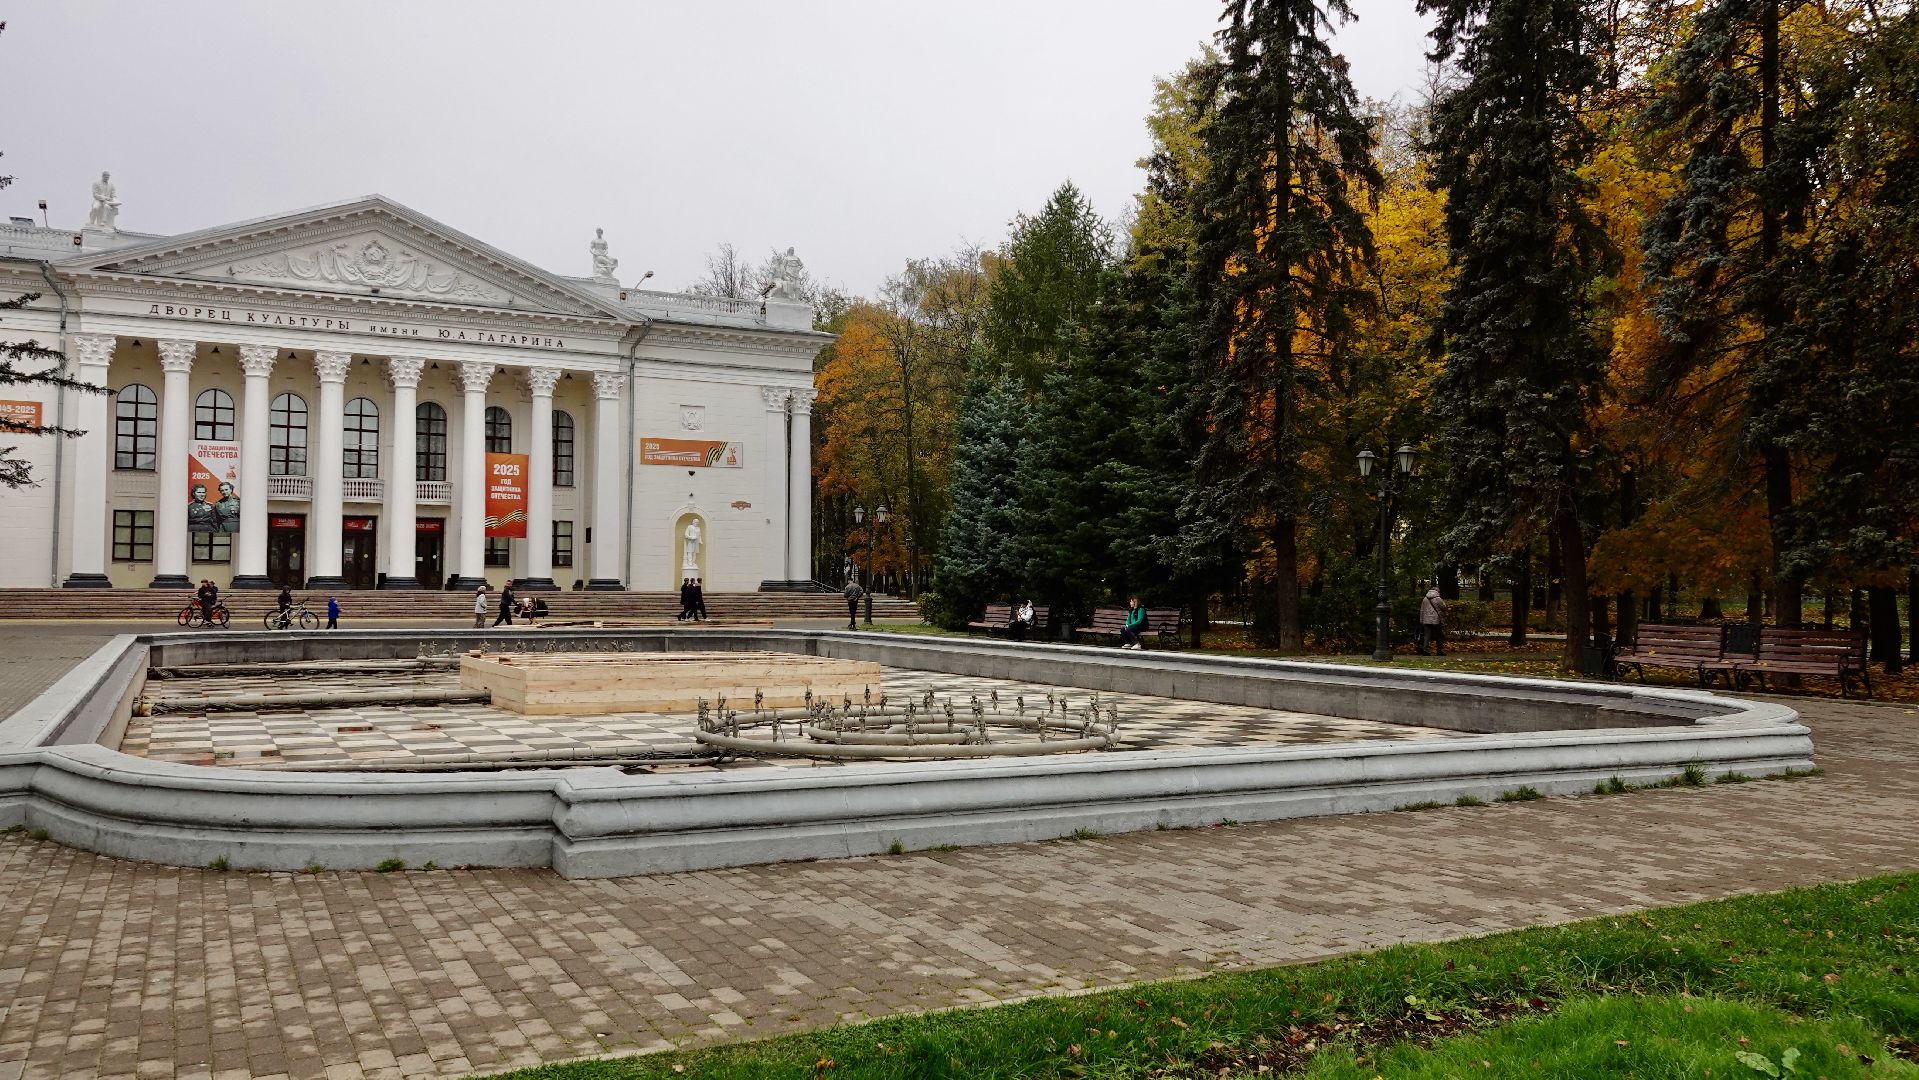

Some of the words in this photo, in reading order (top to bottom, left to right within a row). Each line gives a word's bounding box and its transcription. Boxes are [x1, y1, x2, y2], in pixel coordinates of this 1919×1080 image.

[149, 304, 231, 321] ДВОРЕЦ
[247, 312, 350, 330] КУЛЬТУРЫ
[370, 325, 419, 336] ИМЕНИ
[478, 333, 564, 348] ГАГАРИНА
[0, 404, 36, 414] 45-2025
[493, 464, 520, 476] 2025
